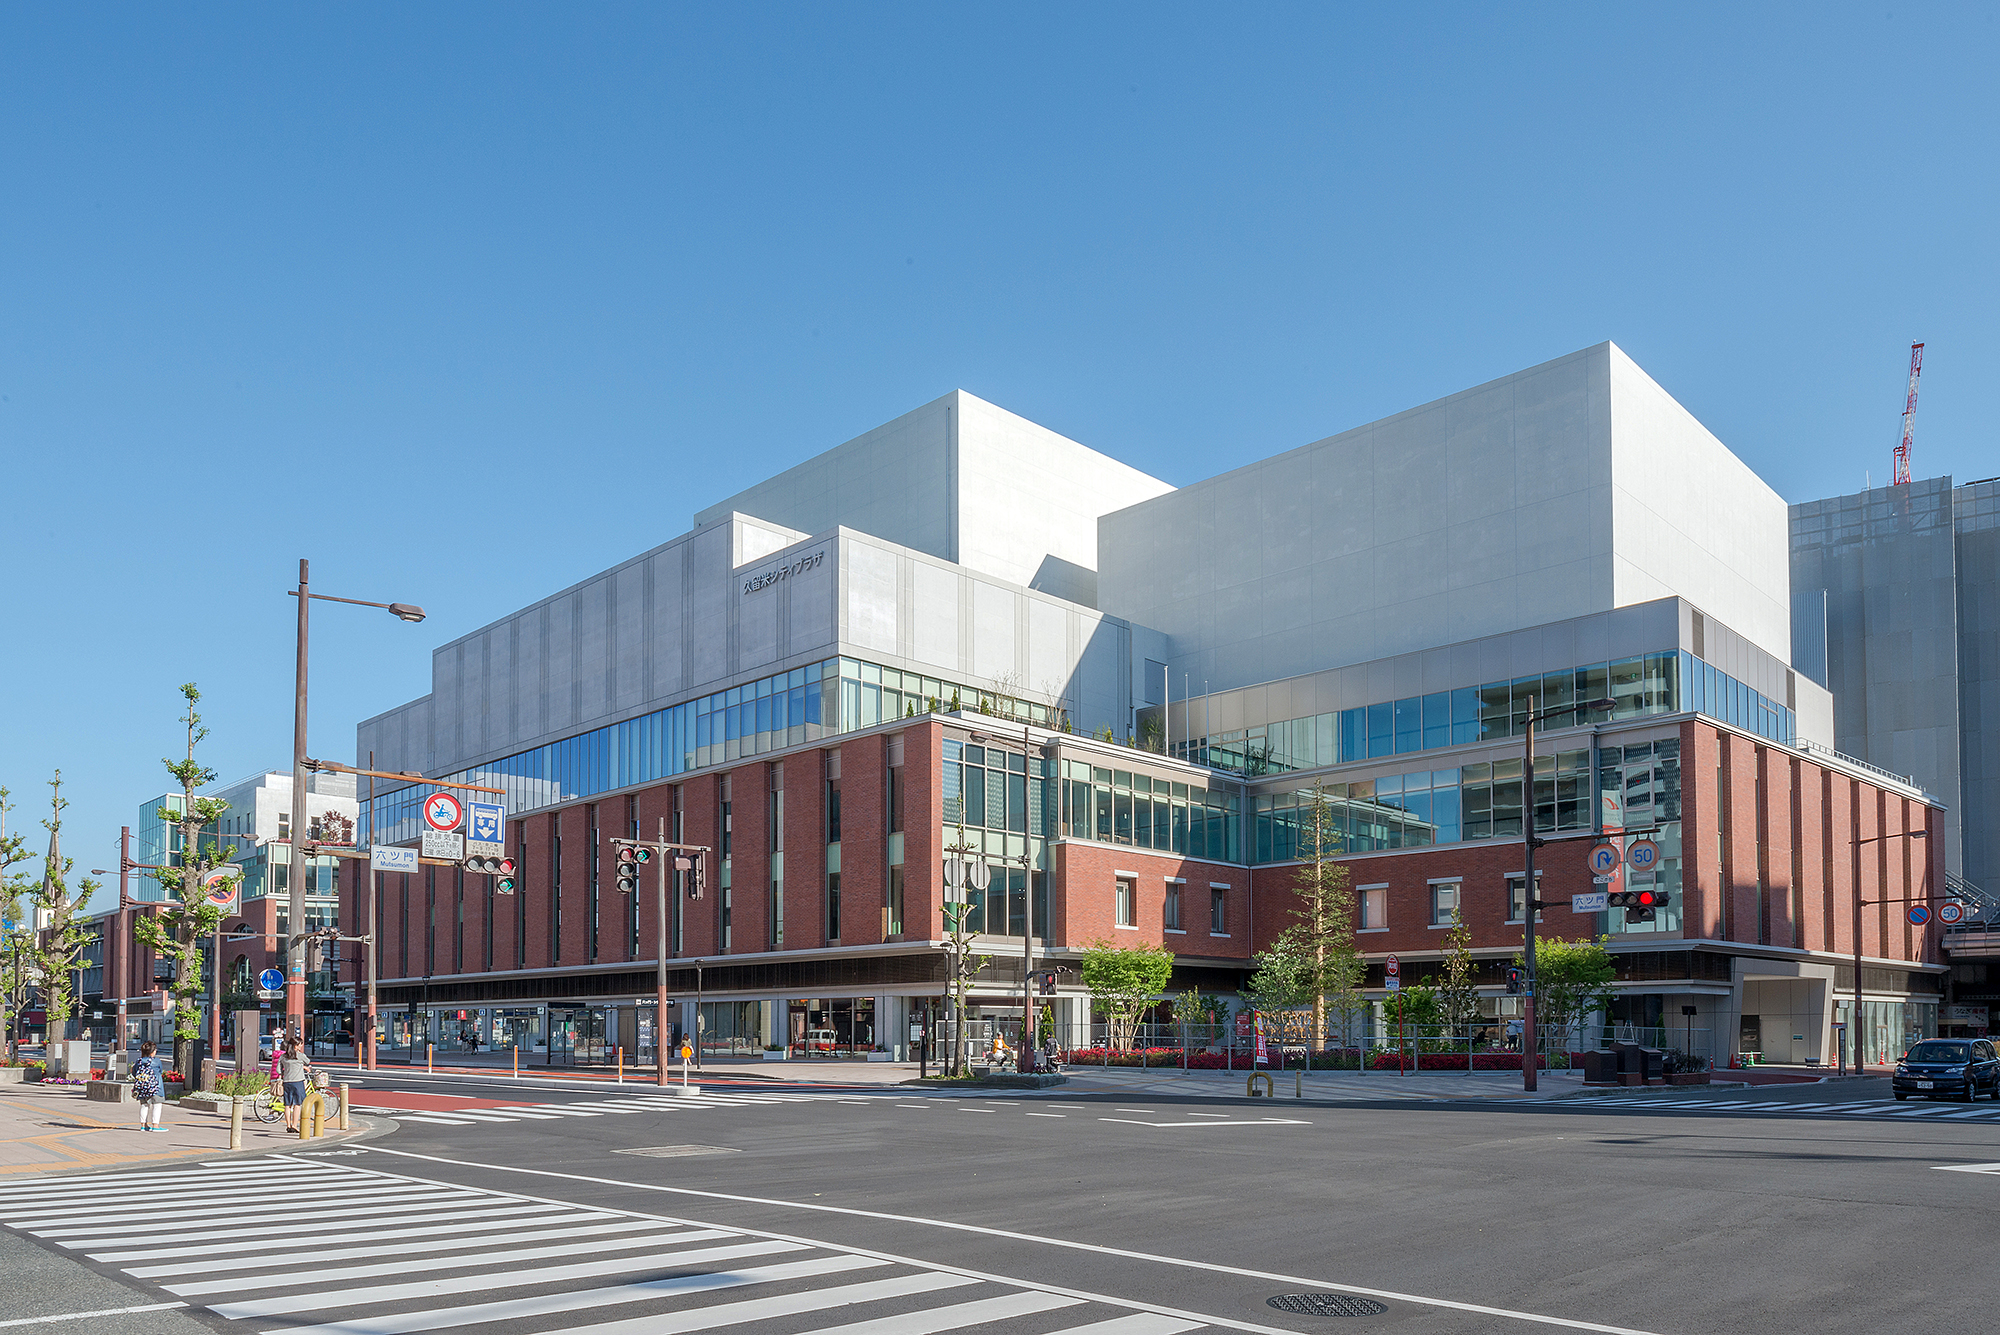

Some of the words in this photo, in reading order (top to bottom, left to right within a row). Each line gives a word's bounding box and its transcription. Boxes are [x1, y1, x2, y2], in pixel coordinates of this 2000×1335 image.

[743, 550, 824, 595] 久留米シティプラザ
[477, 818, 495, 828] 専用
[375, 850, 414, 862] 六ツ門
[1634, 848, 1652, 863] 50
[380, 861, 410, 869] Mutsumon
[1575, 896, 1605, 905] 六ツ門
[1943, 908, 1958, 919] 50
